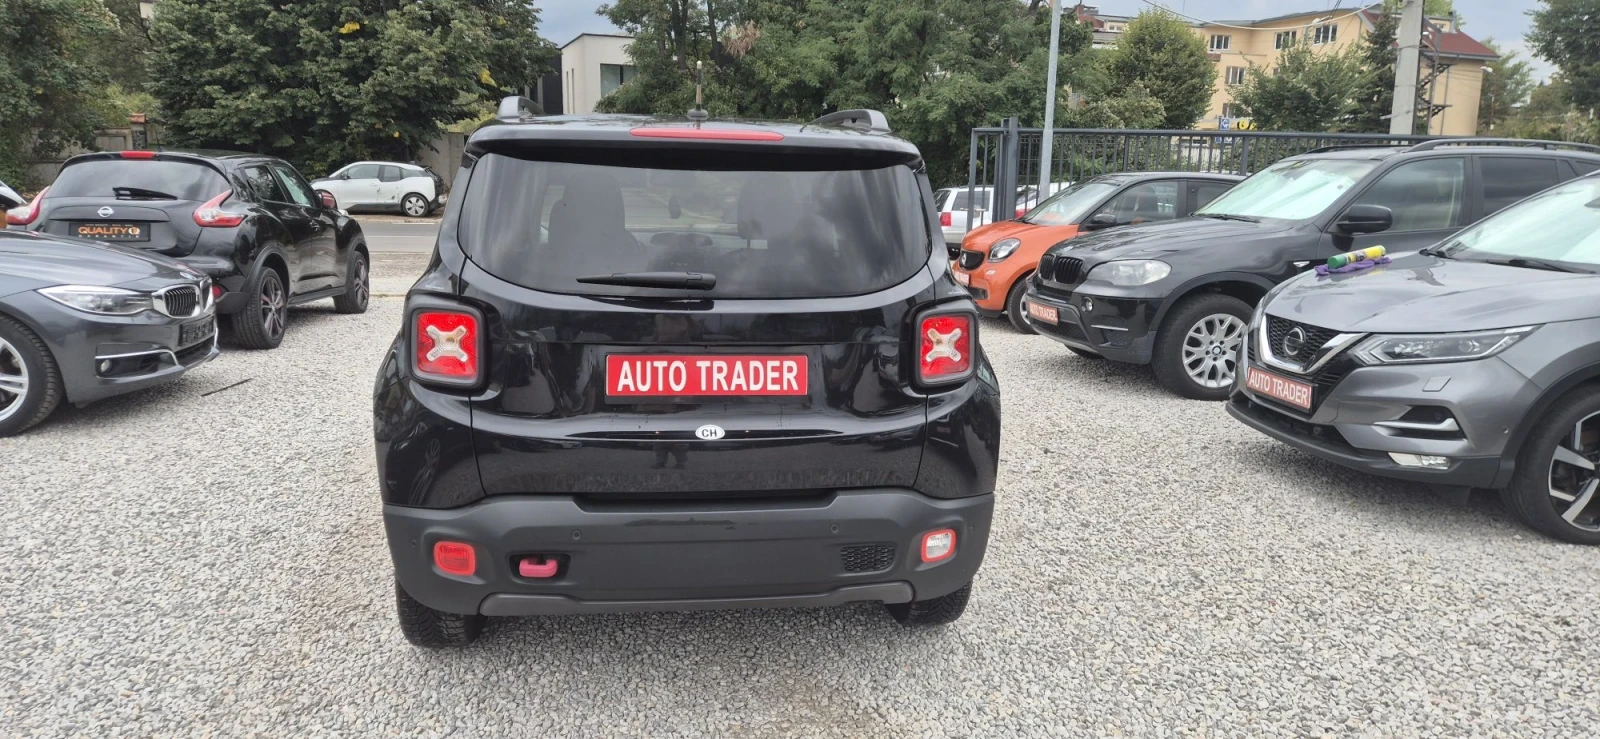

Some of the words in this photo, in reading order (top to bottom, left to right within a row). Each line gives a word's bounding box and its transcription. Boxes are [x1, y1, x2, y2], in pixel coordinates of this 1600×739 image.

[78, 226, 128, 234] QUALITY
[617, 360, 687, 392] AUTO
[696, 360, 799, 391] TRADER
[1249, 370, 1270, 392] AUTO
[1272, 378, 1308, 405] TRADER
[701, 427, 718, 437] CH
